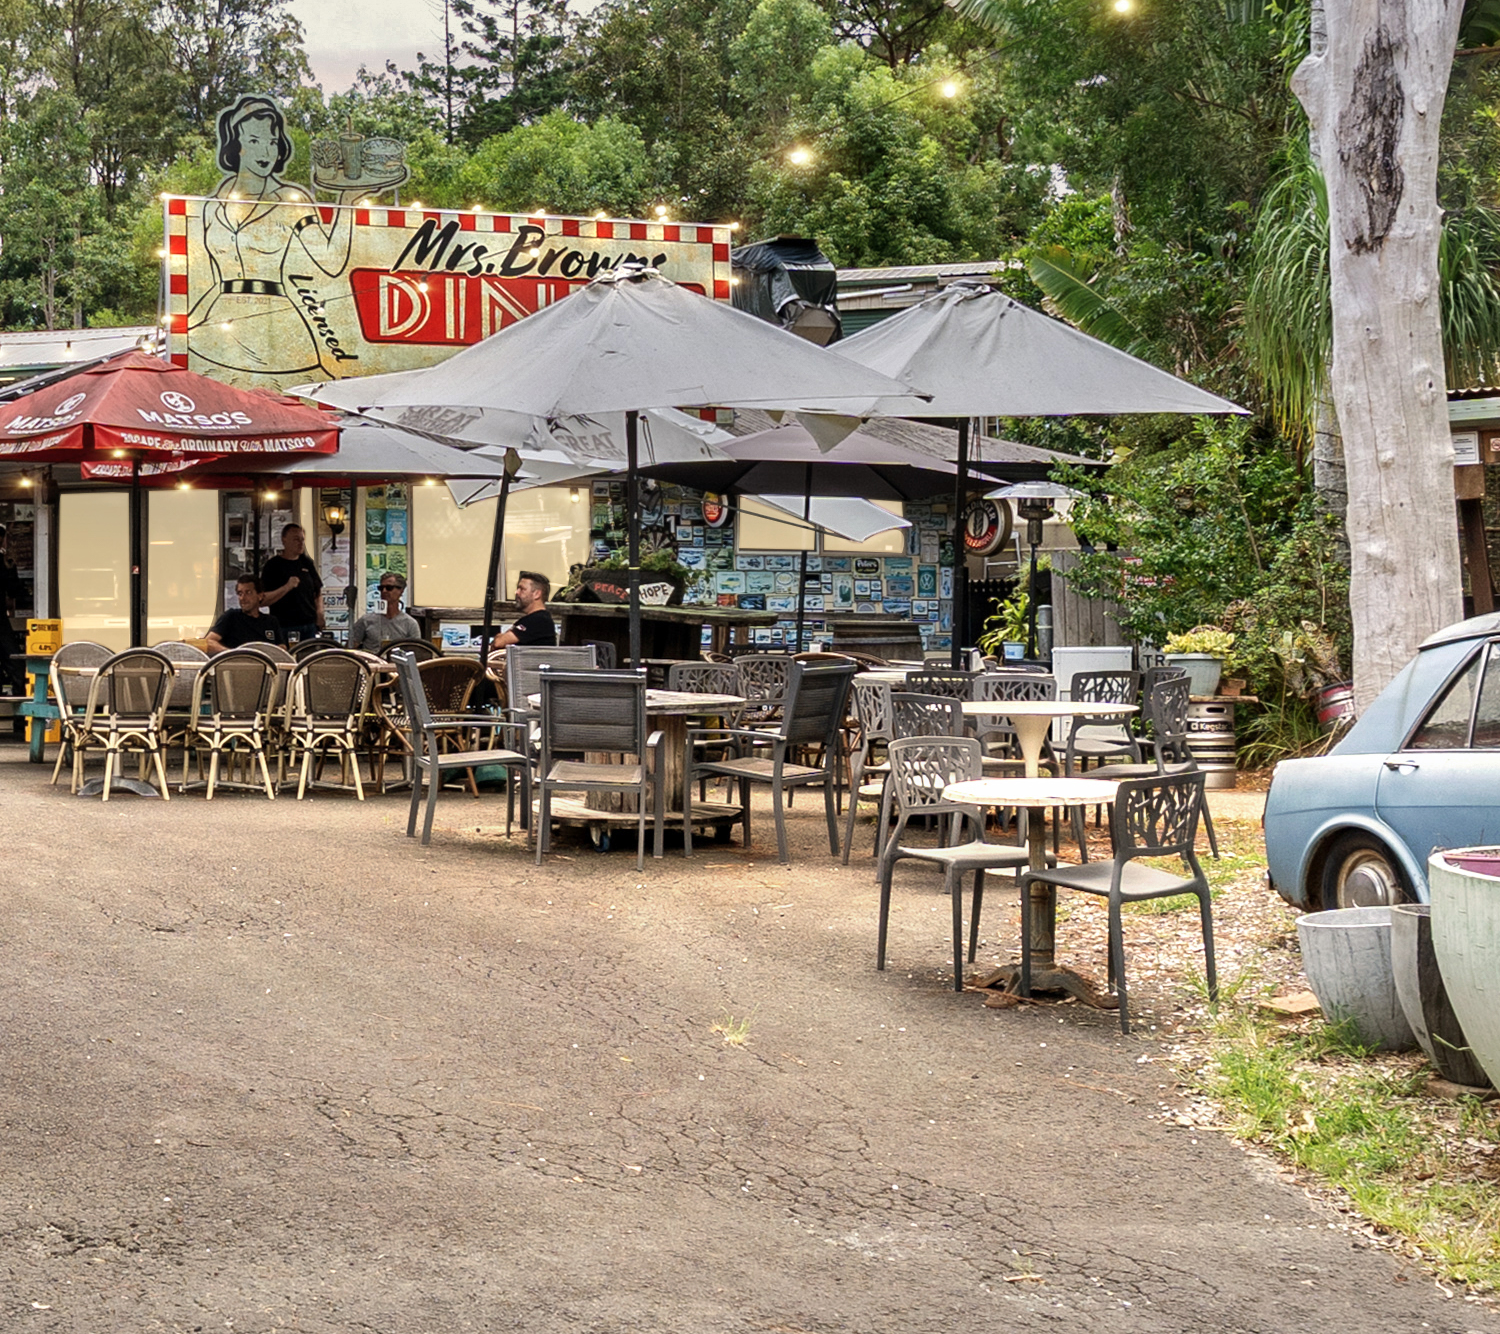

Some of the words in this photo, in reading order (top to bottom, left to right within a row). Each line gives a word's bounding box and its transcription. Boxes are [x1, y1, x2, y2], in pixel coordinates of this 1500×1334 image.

[389, 219, 496, 277] Mrs.
[288, 274, 359, 363] Licensed
[378, 274, 588, 340] DIN
[137, 408, 253, 426] MATSO'S
[963, 500, 997, 521] RDINGER
[639, 584, 669, 600] HOPE
